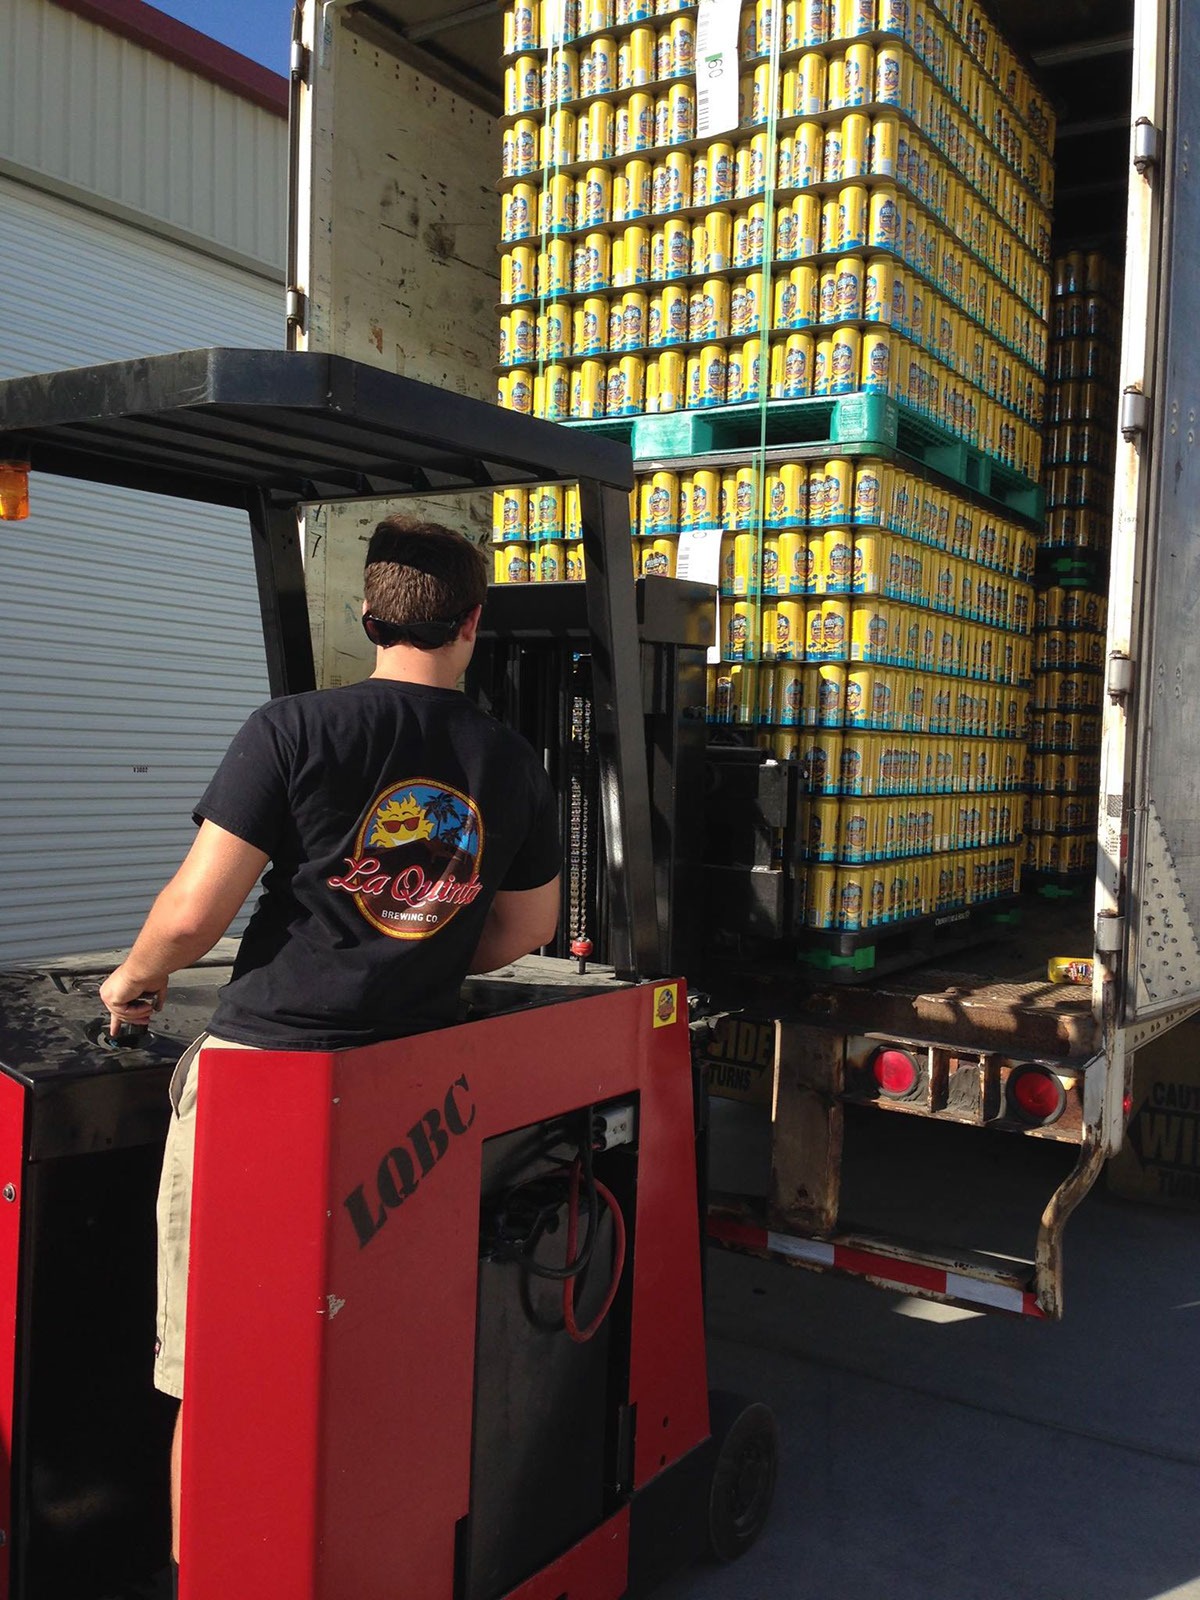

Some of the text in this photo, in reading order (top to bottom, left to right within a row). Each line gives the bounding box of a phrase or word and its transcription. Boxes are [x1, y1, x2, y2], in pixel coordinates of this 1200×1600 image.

[327, 856, 392, 896] La
[381, 909, 424, 922] BREWING
[343, 1073, 476, 1250] LQBC
